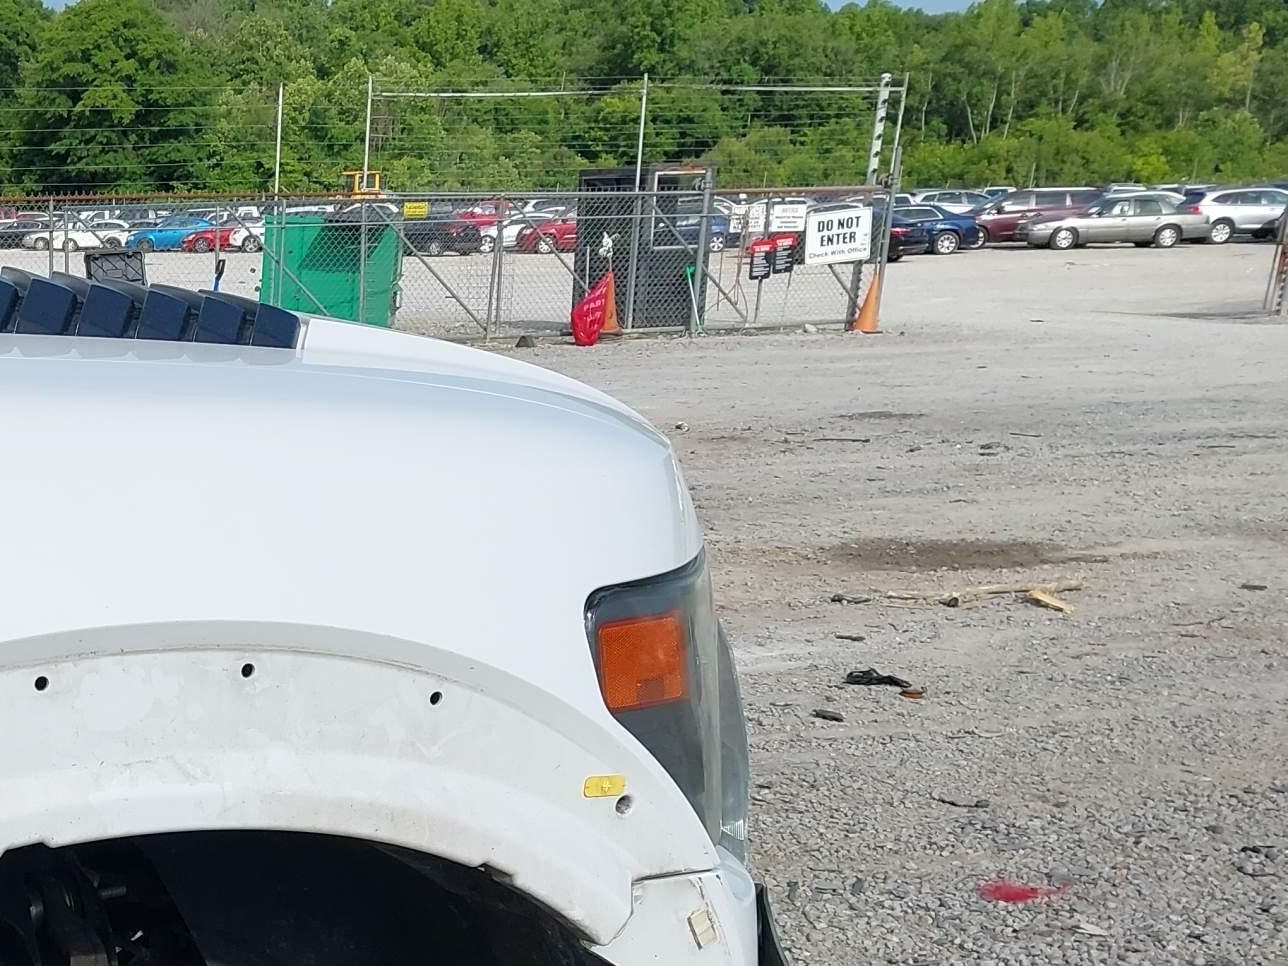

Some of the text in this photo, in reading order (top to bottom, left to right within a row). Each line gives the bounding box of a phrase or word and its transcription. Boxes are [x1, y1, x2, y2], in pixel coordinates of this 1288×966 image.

[817, 219, 834, 233] DO
[837, 215, 861, 231] NOT
[820, 231, 857, 247] ENTER
[808, 247, 867, 260] Check With Office
